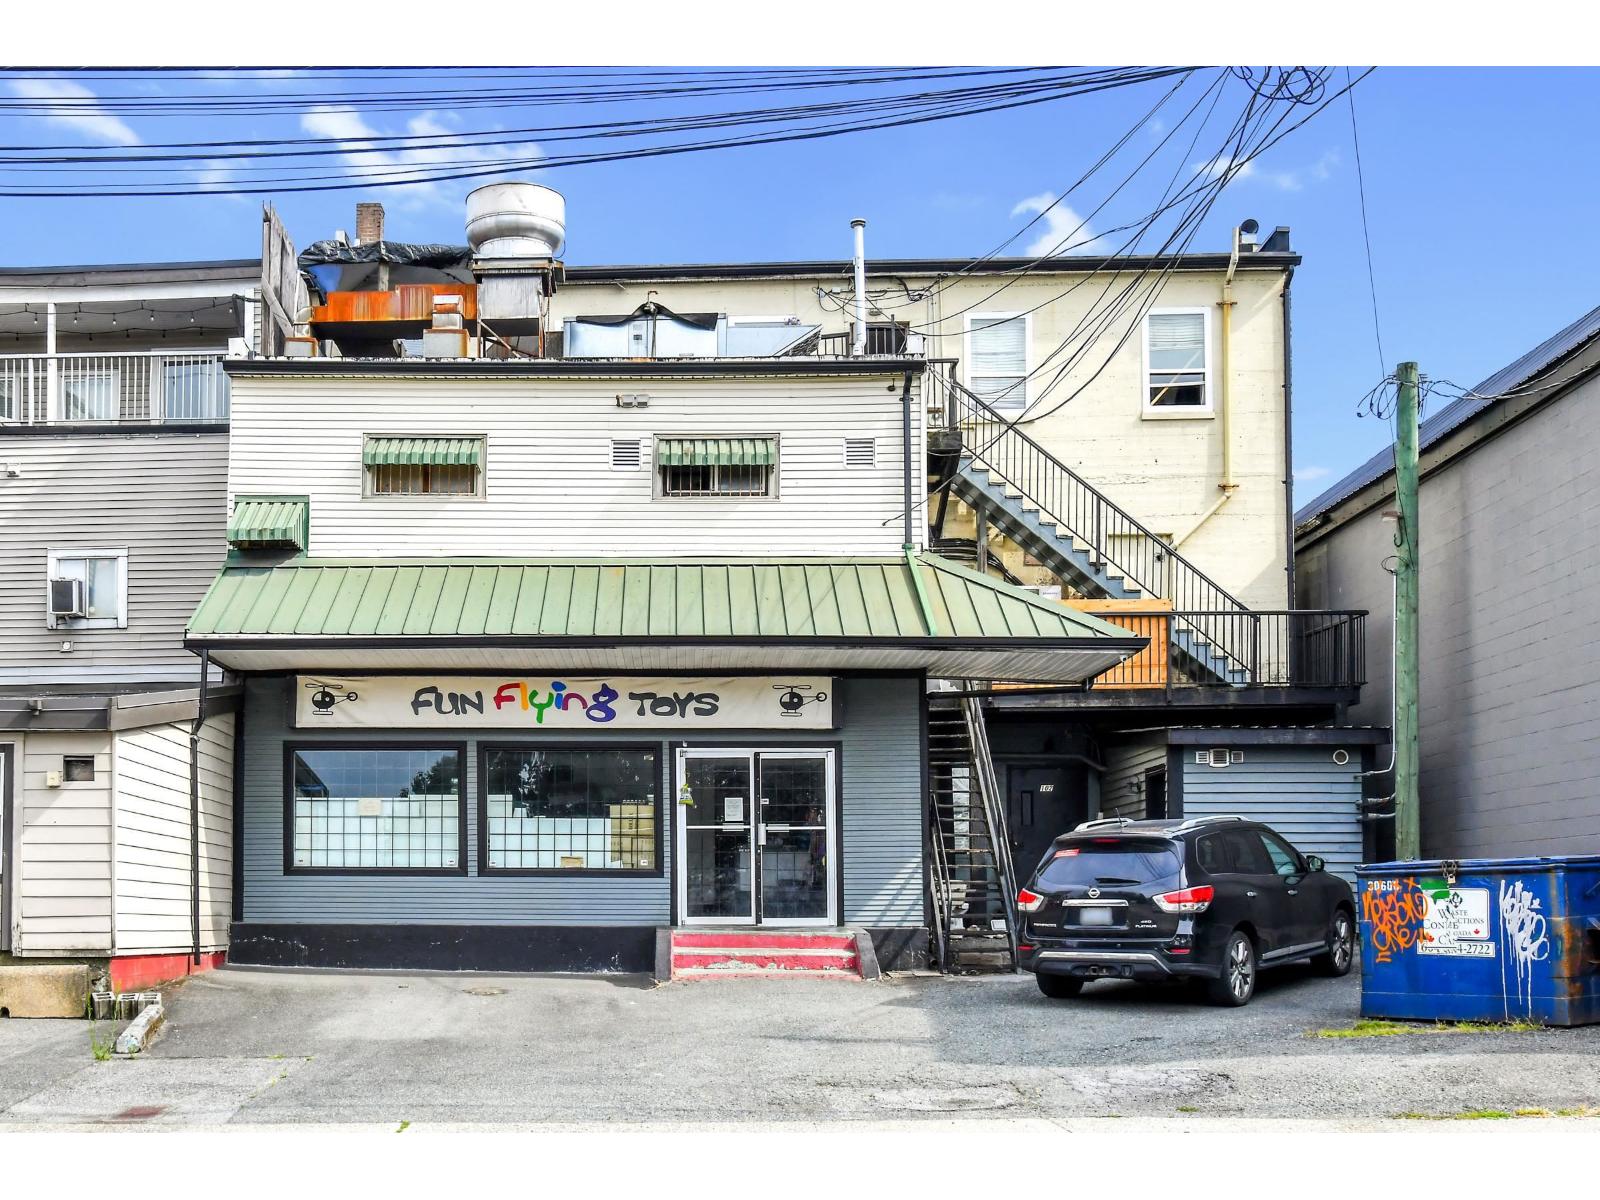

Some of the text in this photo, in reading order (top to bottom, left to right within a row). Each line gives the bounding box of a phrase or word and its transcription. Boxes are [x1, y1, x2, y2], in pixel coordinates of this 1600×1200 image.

[411, 681, 720, 724] FUN Flying TOYS
